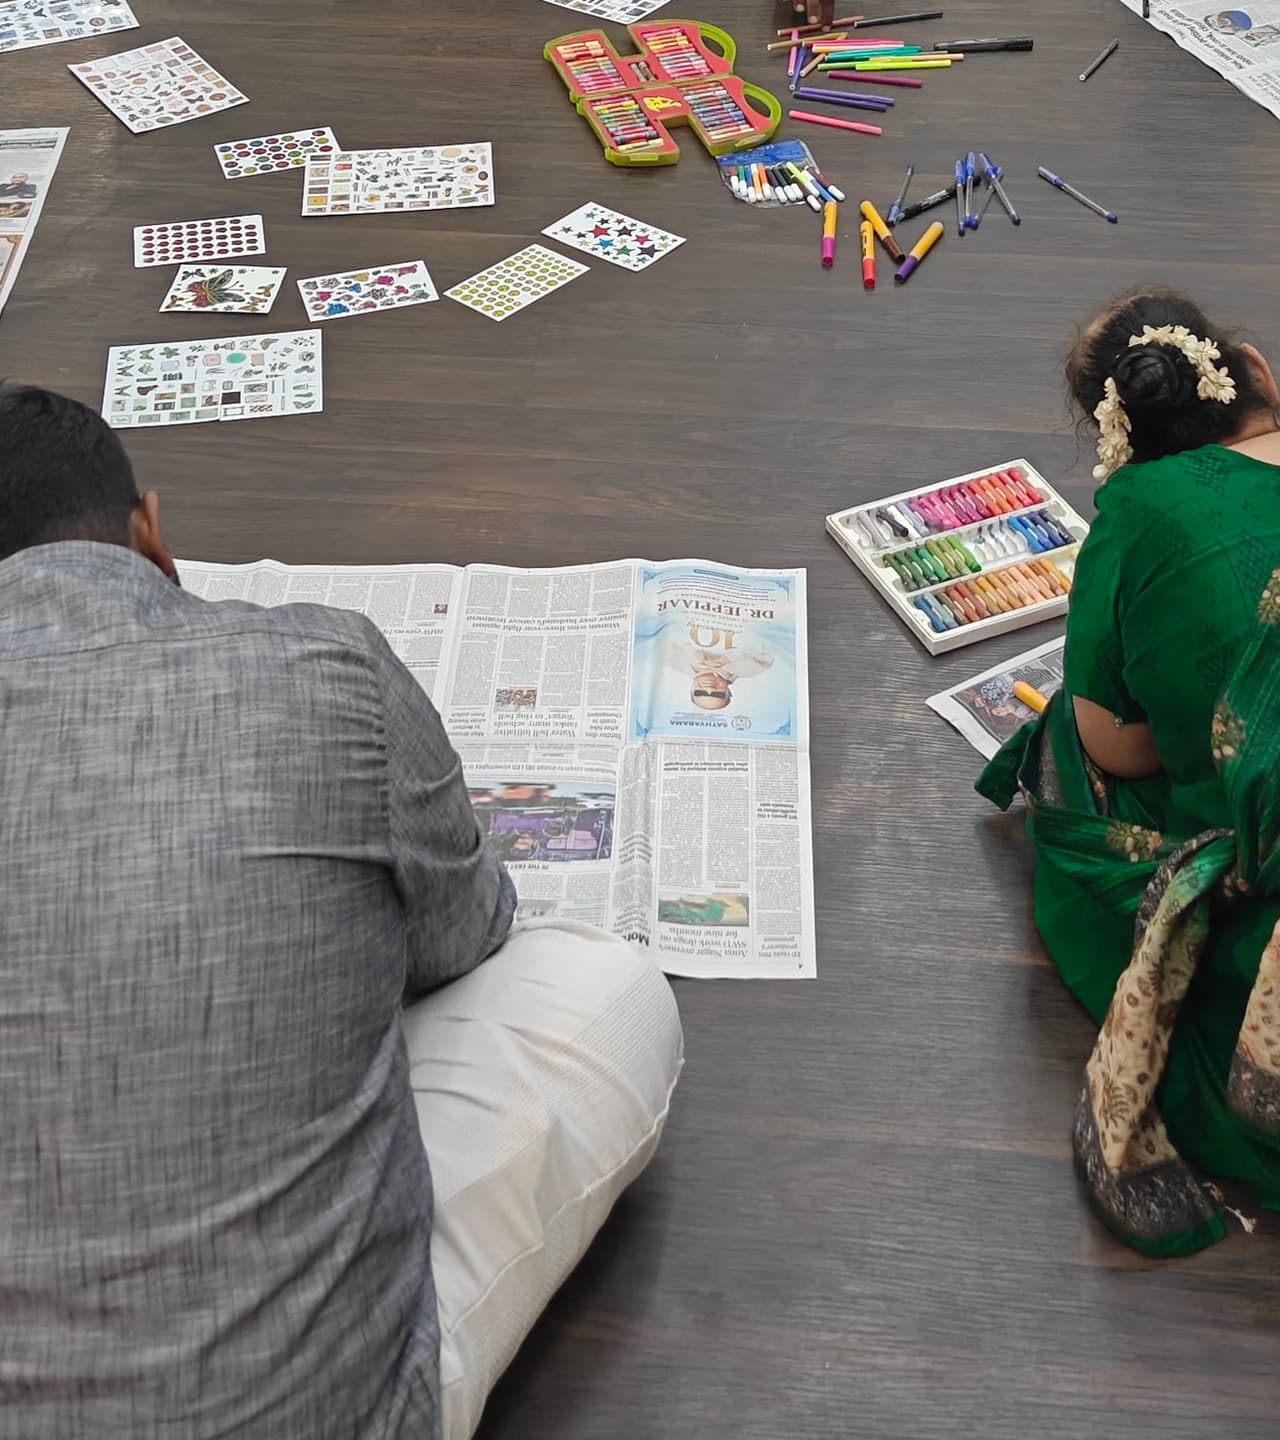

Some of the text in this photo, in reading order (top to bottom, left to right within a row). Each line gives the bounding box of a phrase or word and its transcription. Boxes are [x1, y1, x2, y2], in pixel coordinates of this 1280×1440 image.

[657, 599, 774, 619] DR. JEPPIAAR
[466, 616, 506, 625] treatment
[538, 618, 577, 626] husband's
[579, 617, 597, 625] over
[599, 613, 627, 623] insurer
[472, 622, 501, 631] against
[567, 624, 587, 632] wins
[588, 622, 619, 632] Woman
[688, 625, 737, 651] 10
[498, 713, 515, 721] bell
[517, 712, 532, 720] ring
[529, 720, 550, 728] many
[670, 720, 728, 728] SATHYABAMA
[493, 729, 576, 738] Water bell initiative
[669, 927, 738, 938] for nine months
[673, 936, 697, 946] drags
[699, 939, 721, 947] work
[723, 941, 746, 949] SWD
[697, 947, 722, 958] Nagar
[725, 949, 748, 958] Anna
